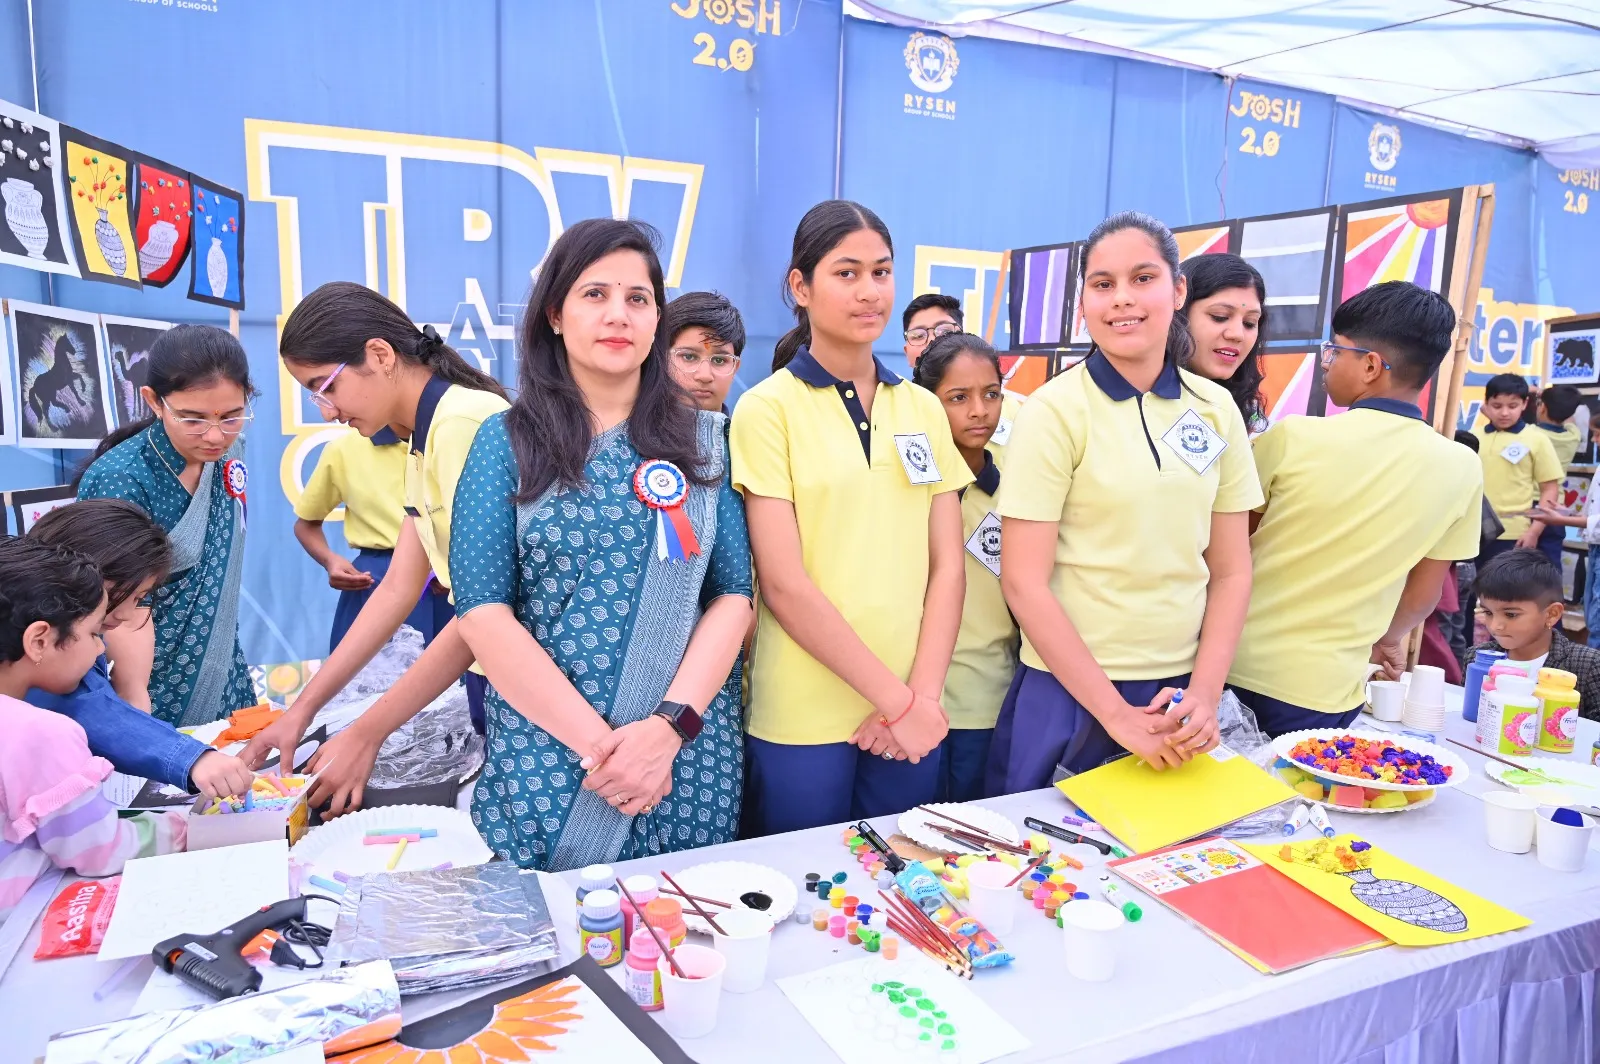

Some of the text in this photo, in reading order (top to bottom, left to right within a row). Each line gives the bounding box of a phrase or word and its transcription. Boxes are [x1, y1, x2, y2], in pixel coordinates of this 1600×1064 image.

[176, 1, 218, 13] SCHOOLS
[692, 32, 755, 72] 2.0
[904, 93, 956, 113] RYSEN
[1229, 91, 1301, 128] JOSH
[1239, 126, 1280, 157] 2.0
[1563, 190, 1588, 214] 2.0
